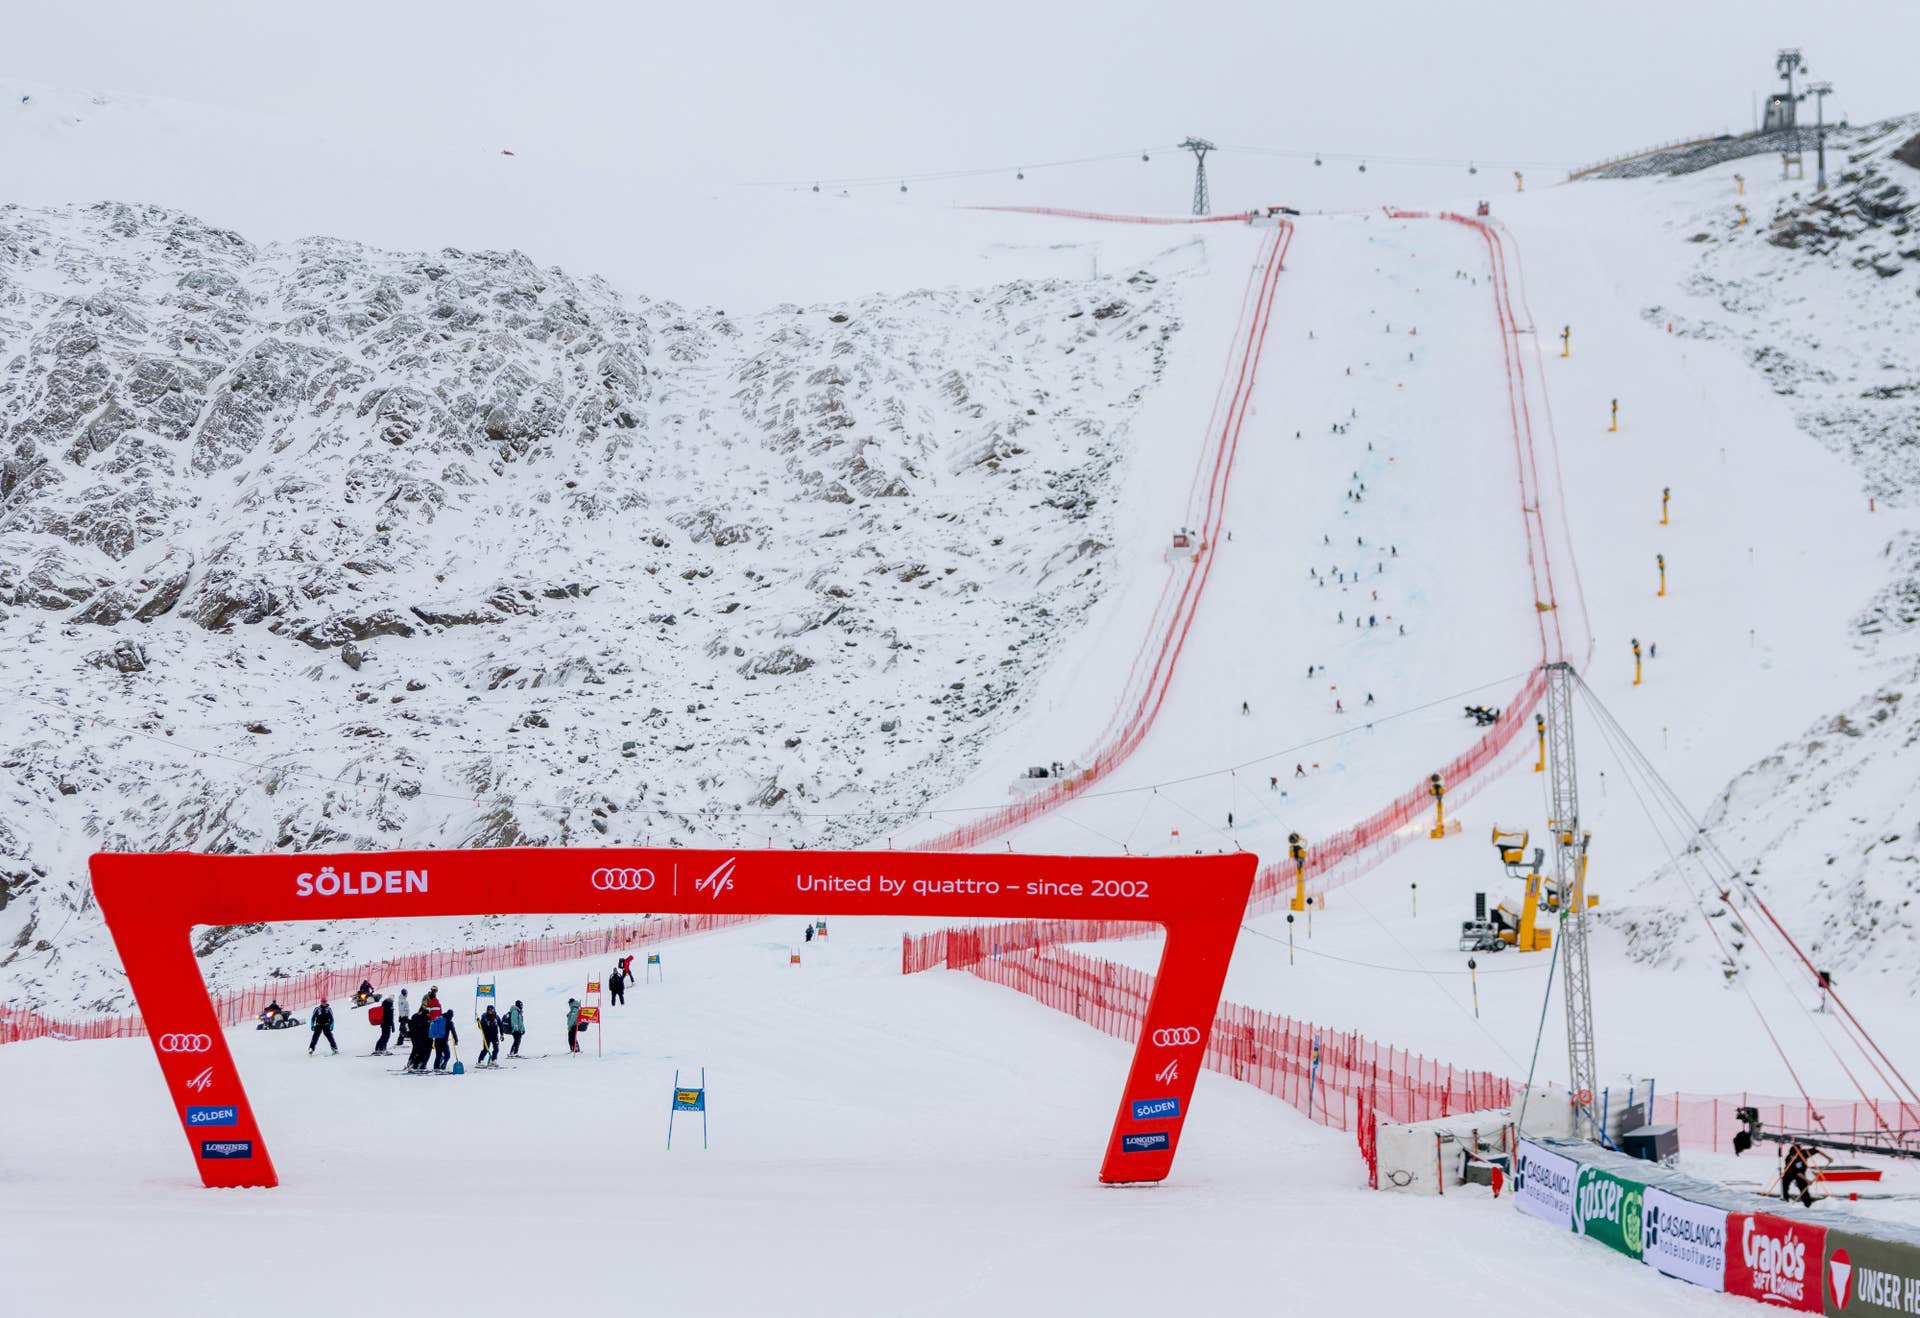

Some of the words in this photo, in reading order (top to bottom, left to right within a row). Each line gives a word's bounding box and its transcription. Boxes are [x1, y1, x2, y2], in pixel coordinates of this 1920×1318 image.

[296, 866, 429, 897] SÖLDEN
[797, 874, 872, 893] United
[879, 874, 907, 897] by
[912, 877, 1000, 897] quattro
[1026, 877, 1084, 896] since
[1090, 878, 1150, 899] 2002
[191, 1109, 233, 1123] SÖLDEN
[1137, 1101, 1175, 1117] SÖLDEN
[206, 1143, 249, 1151] LONGINES
[1126, 1135, 1165, 1145] LONGINES
[1526, 1161, 1570, 1196] CASABLANCA
[1660, 1213, 1722, 1250] CASABLANCA
[1857, 1266, 1901, 1310] UNSER
